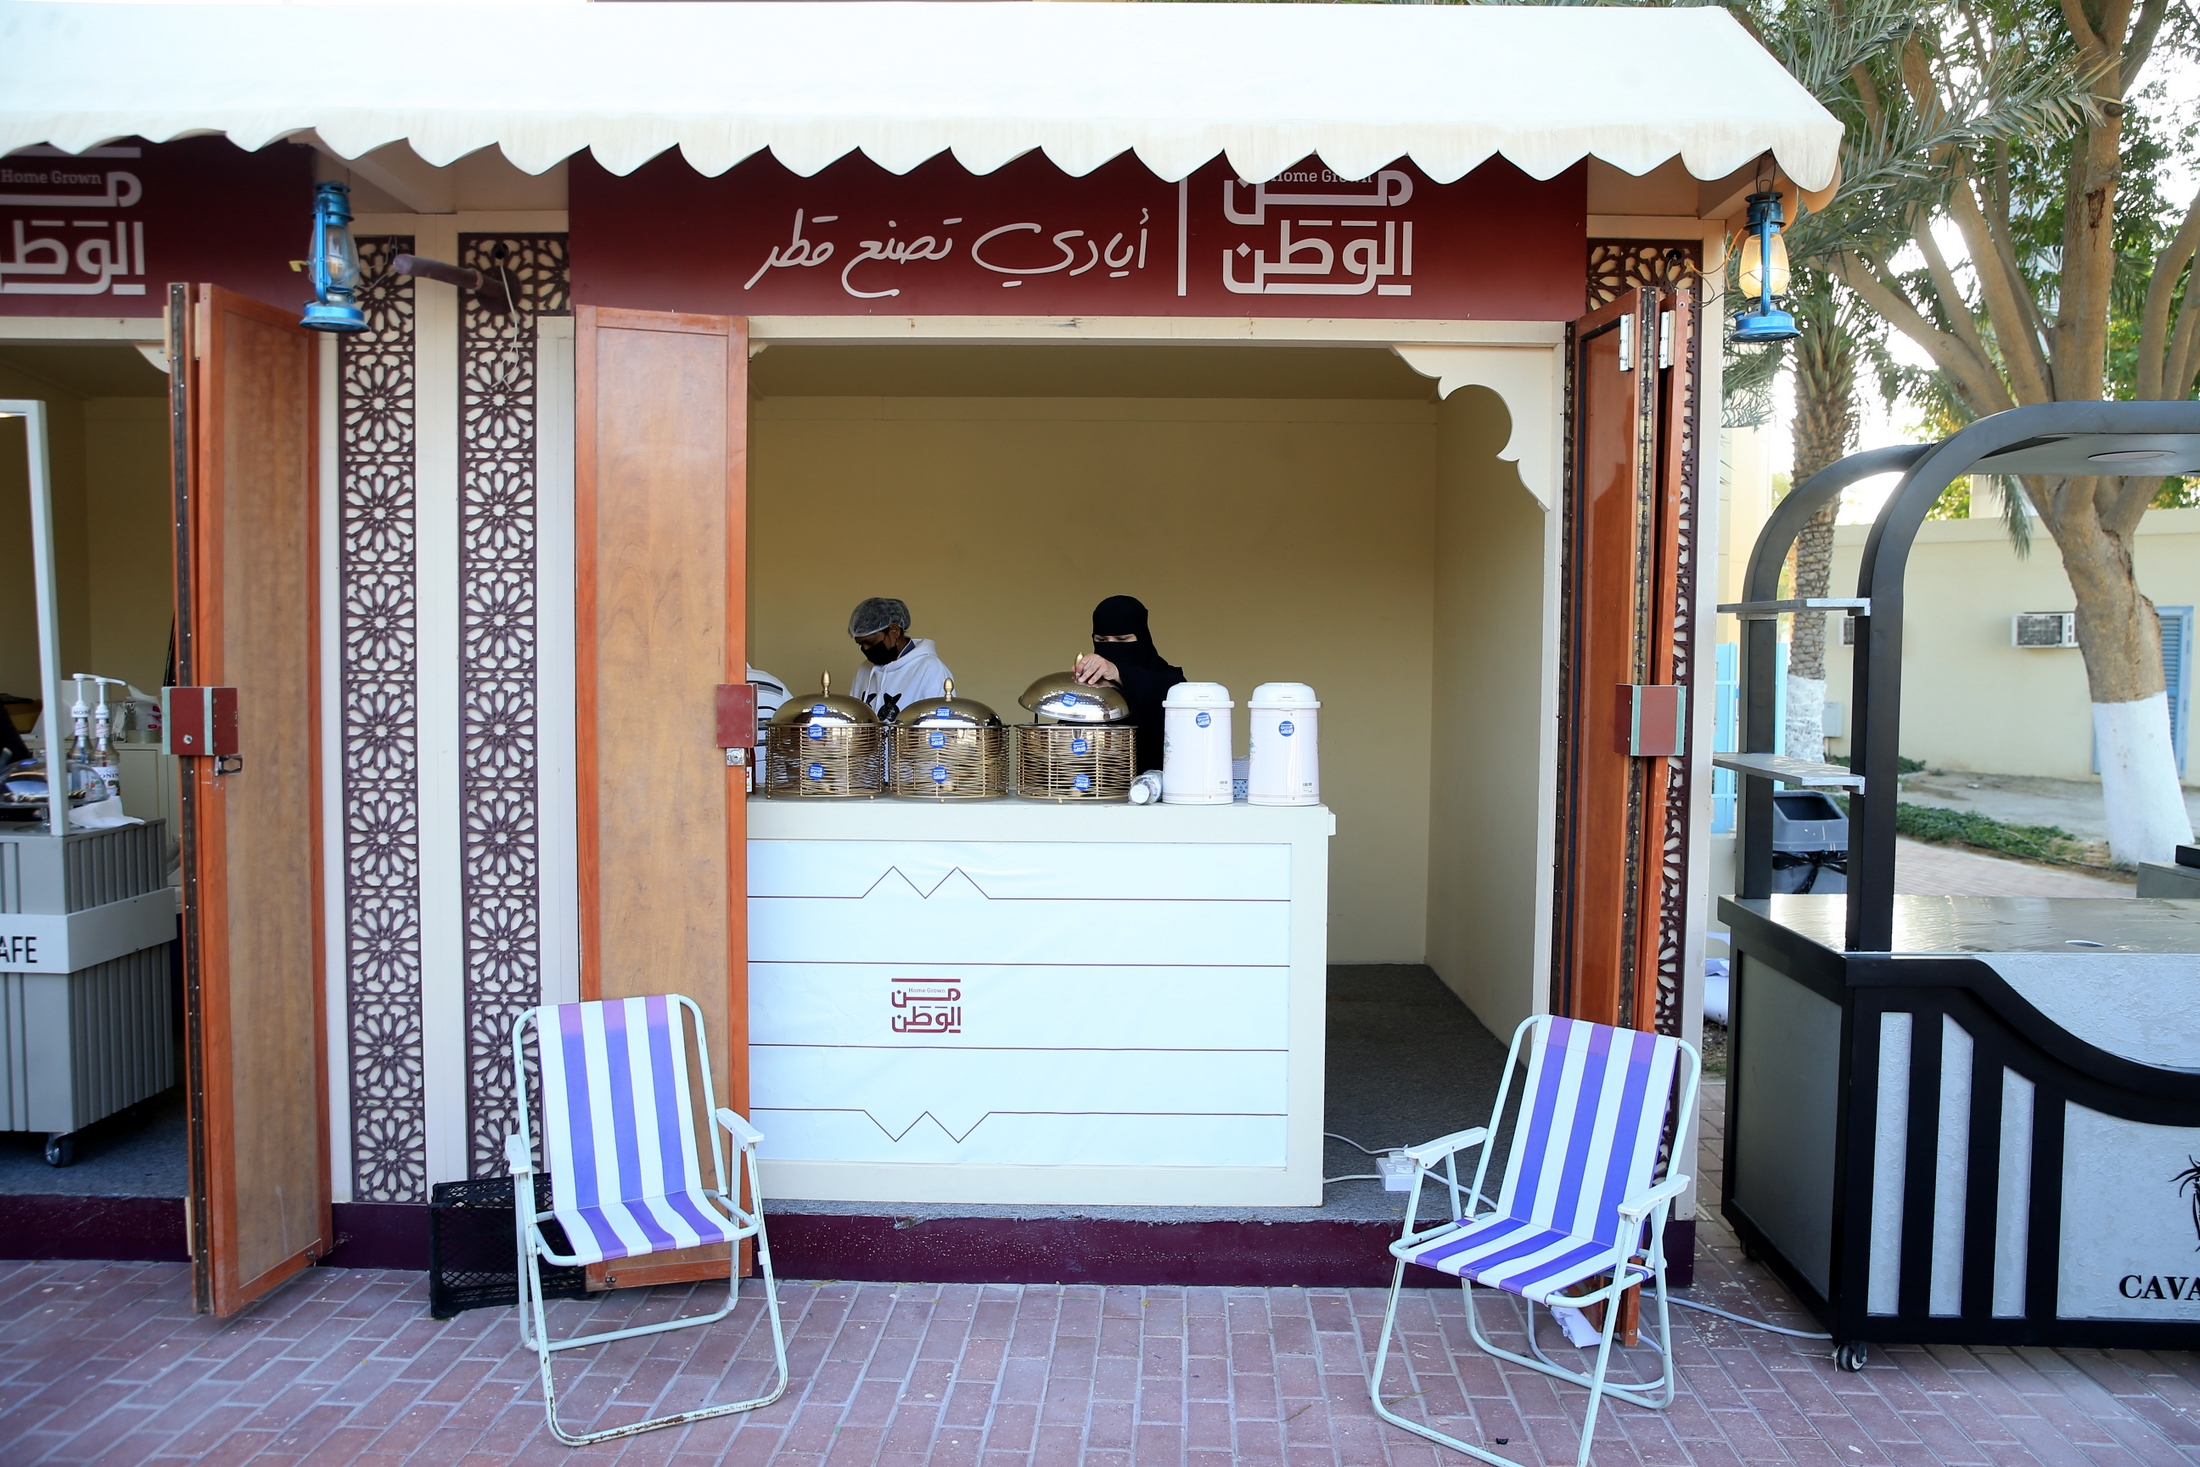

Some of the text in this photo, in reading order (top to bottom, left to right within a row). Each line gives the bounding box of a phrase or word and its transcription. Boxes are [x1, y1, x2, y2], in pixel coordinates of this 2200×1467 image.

[1, 169, 102, 185] Home Grown
[743, 207, 1150, 298] أيادي تصنع قطر
[1222, 219, 1414, 297] الوطن
[891, 1005, 962, 1034] الوطن
